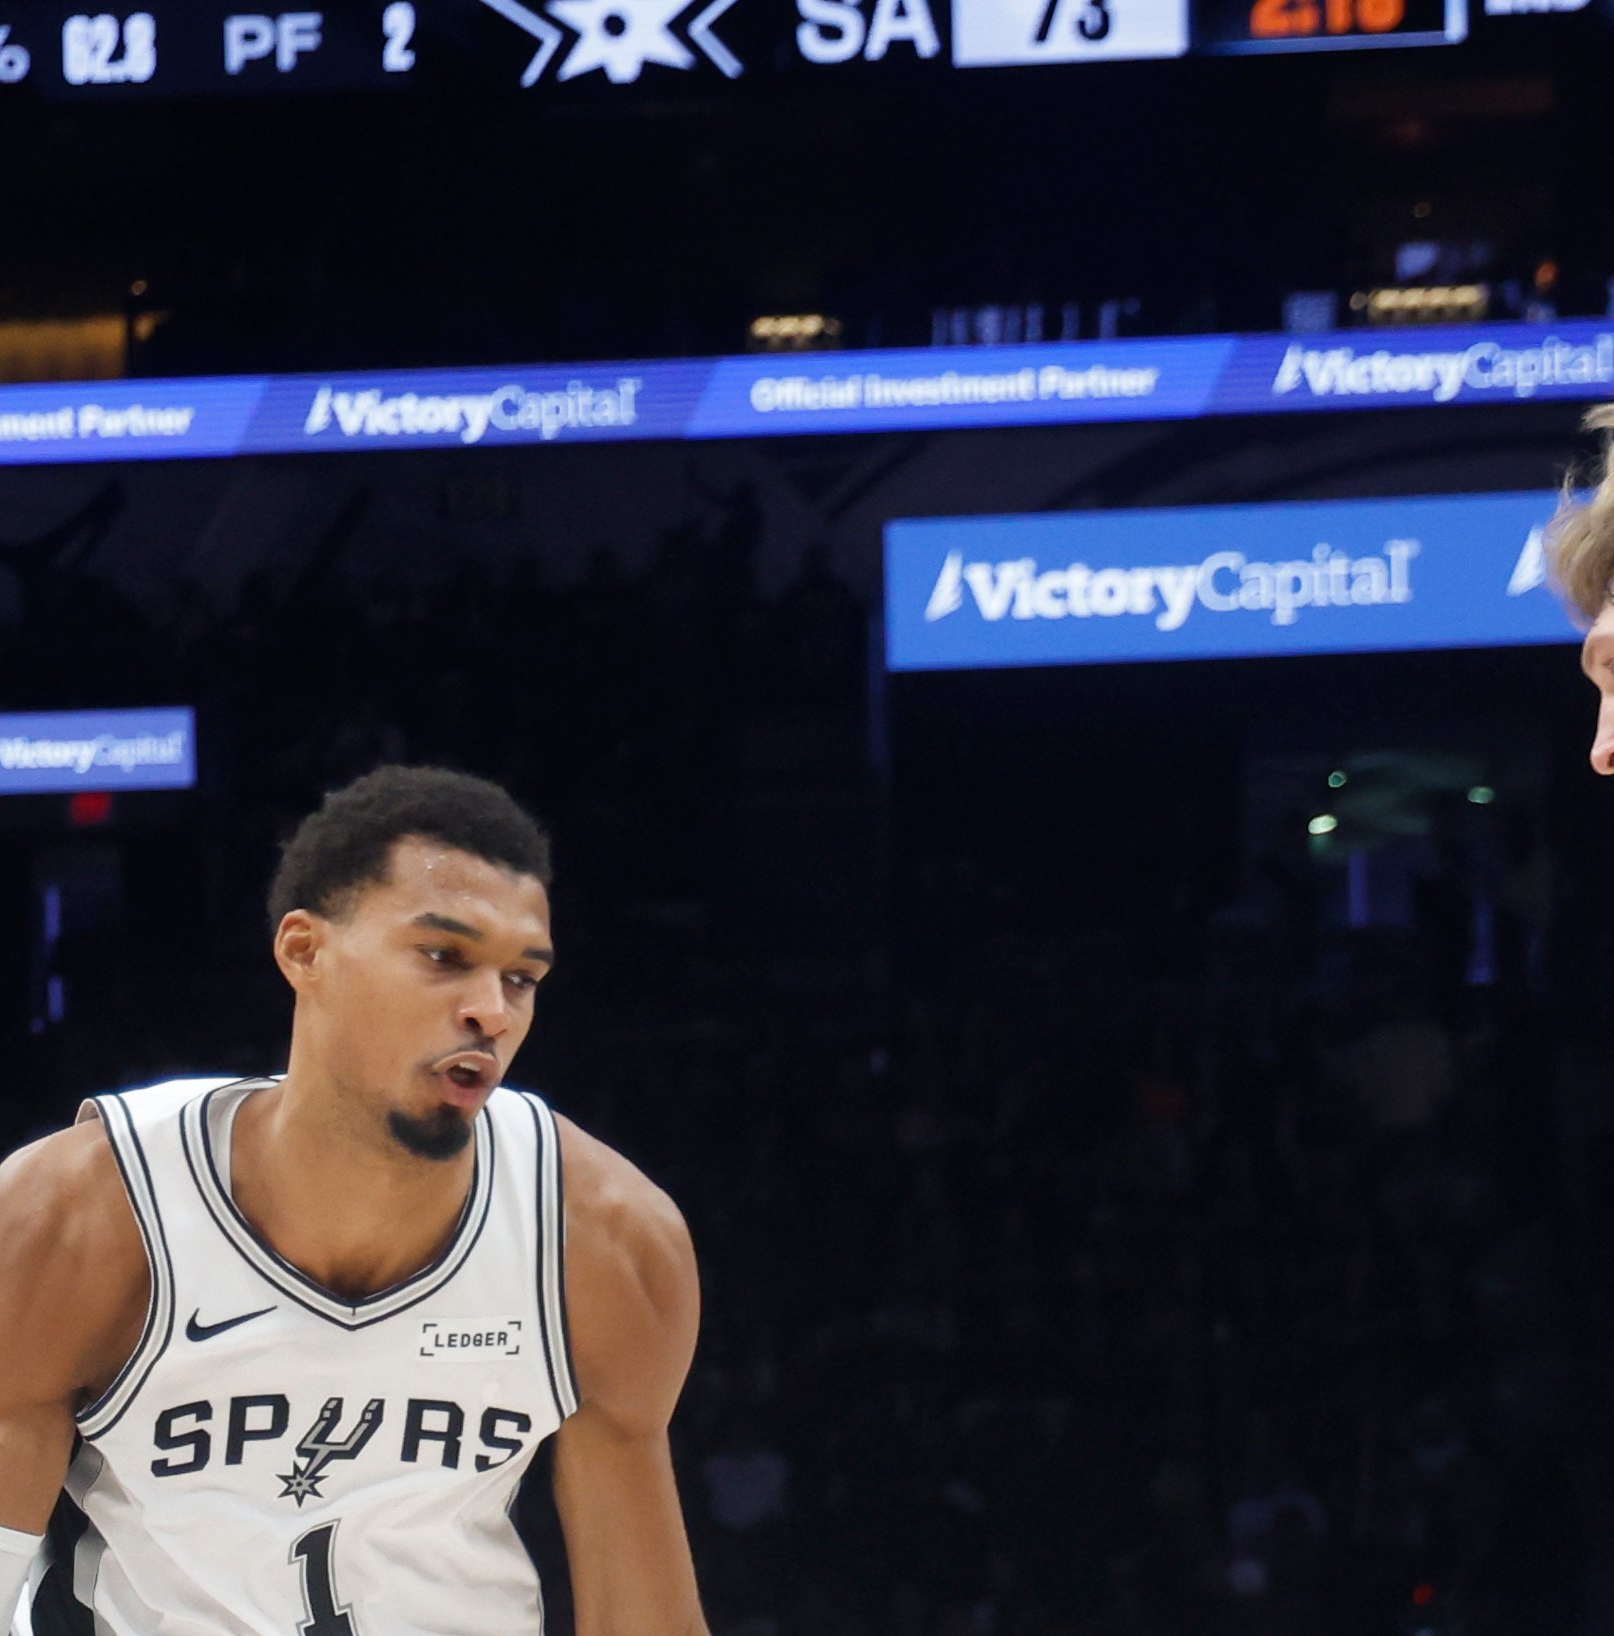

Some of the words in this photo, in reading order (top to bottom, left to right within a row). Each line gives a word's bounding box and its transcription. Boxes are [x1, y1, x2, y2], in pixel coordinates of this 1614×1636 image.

[224, 12, 322, 74] PF
[382, 1, 417, 72] 2
[750, 372, 863, 414] Official
[1039, 364, 1160, 402] Partner
[78, 404, 195, 440] Partner
[433, 1331, 508, 1349] LEDGER
[151, 1393, 532, 1508] SPURS
